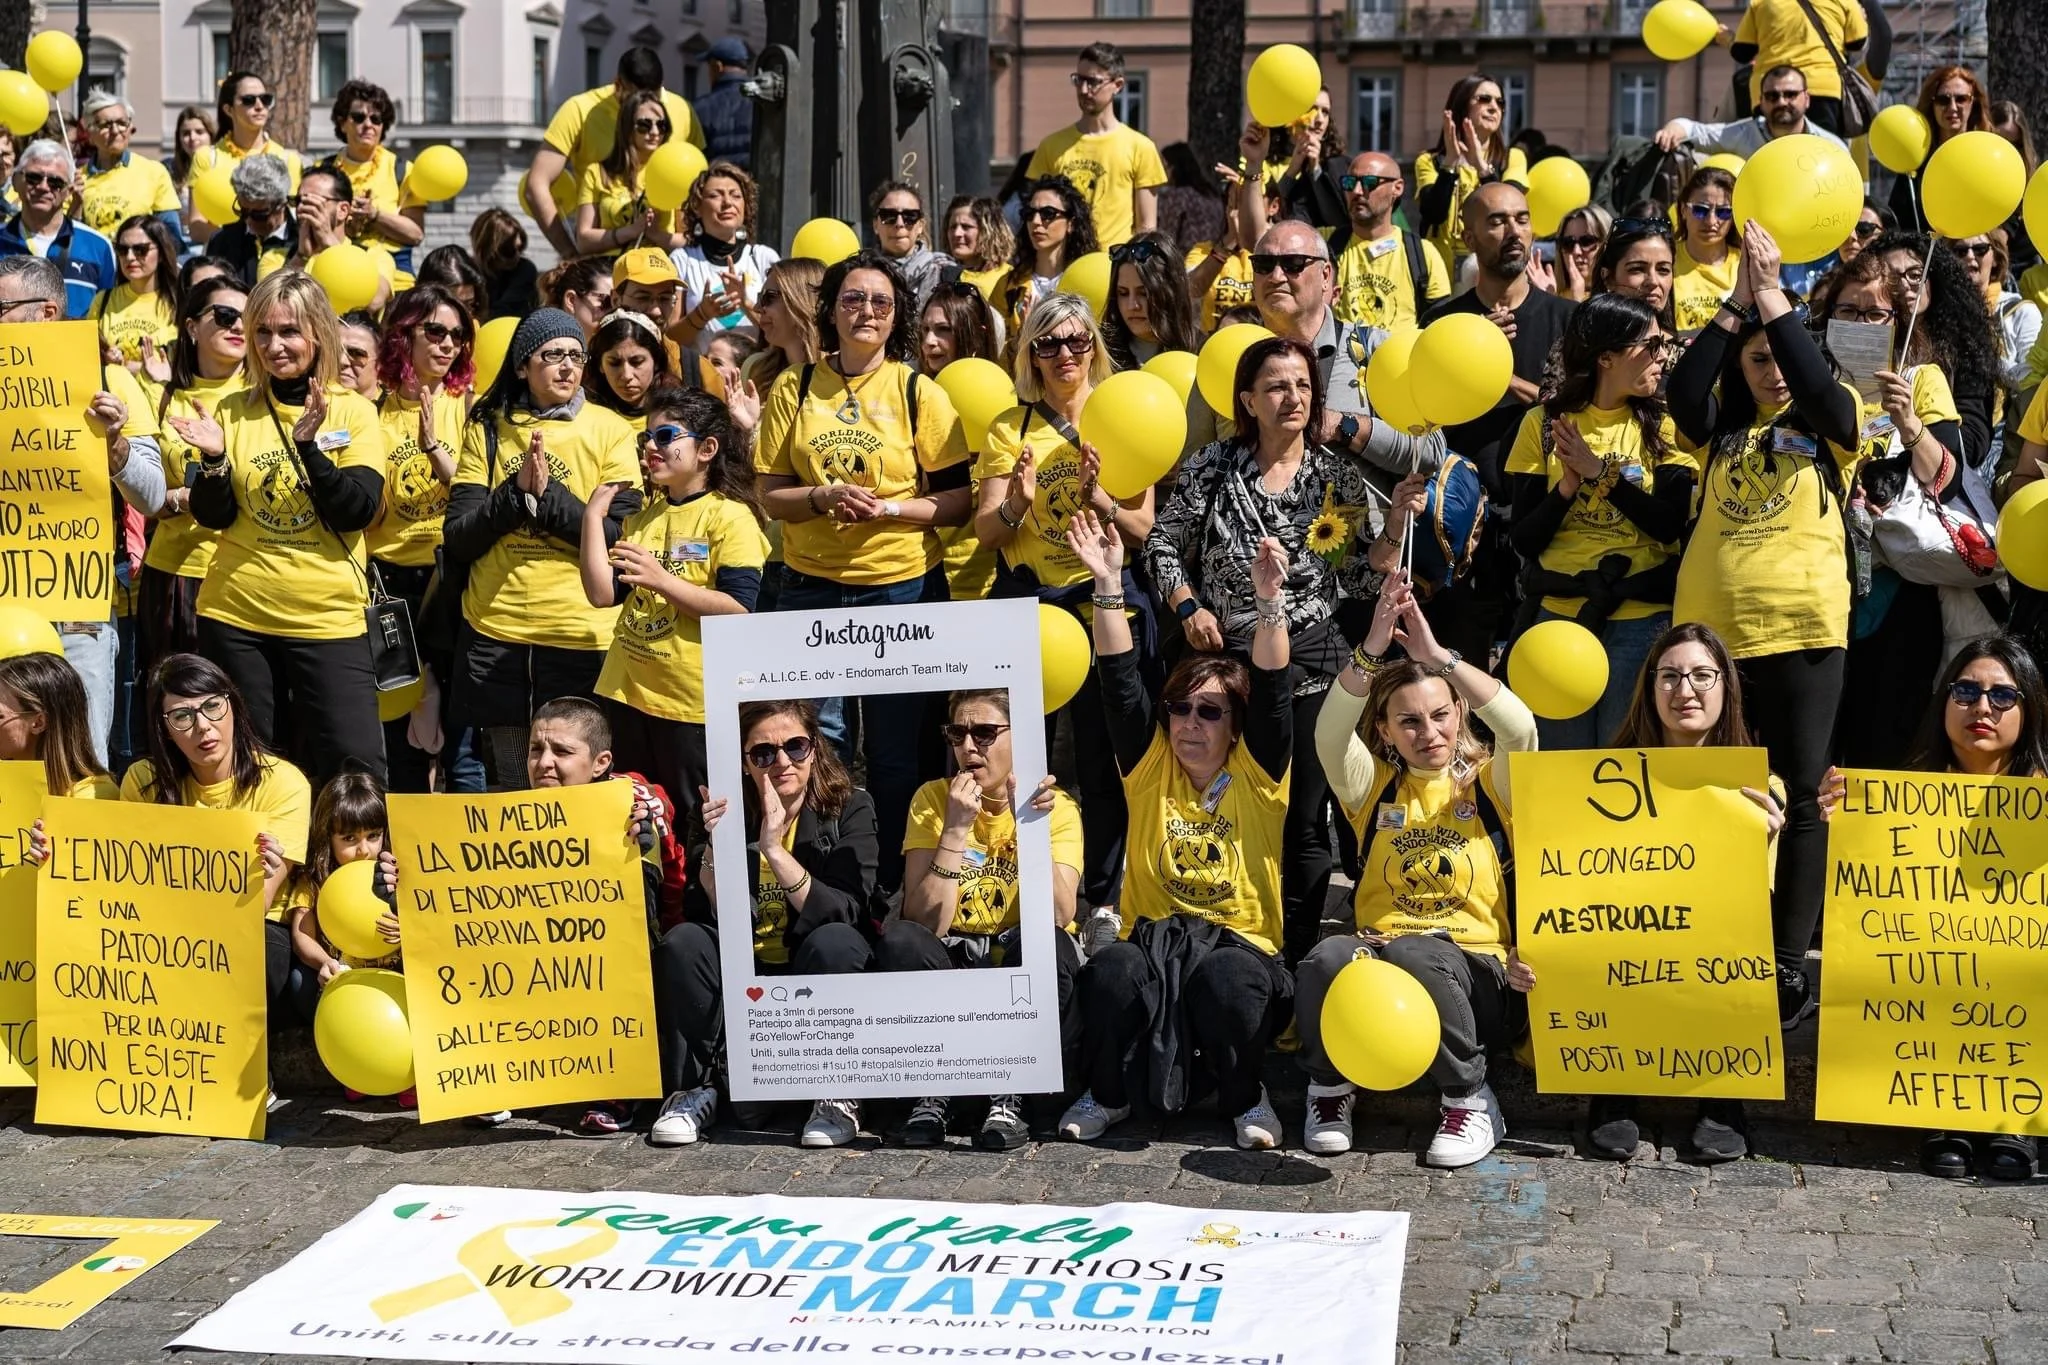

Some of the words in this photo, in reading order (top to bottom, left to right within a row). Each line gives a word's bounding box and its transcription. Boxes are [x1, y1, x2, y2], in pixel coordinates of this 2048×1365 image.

[902, 151, 918, 177] 2
[11, 428, 82, 451] AGILE
[808, 429, 884, 449] WORLDWIDE
[814, 437, 876, 455] ENDOMARCH
[28, 502, 45, 515] AL
[257, 508, 281, 527] 2014
[1722, 497, 1749, 516] 2014
[28, 517, 99, 541] LAVORO
[64, 551, 110, 600] NOI
[804, 618, 935, 659] Instagram
[759, 669, 812, 684] A.L.I.C.E.
[814, 670, 835, 681] odv
[845, 665, 909, 679] Endomarch
[912, 662, 942, 676] Team
[945, 661, 969, 675] Italy
[1843, 776, 2048, 821] L'ENDOMETRIO
[464, 804, 489, 833] IN
[500, 801, 568, 832] MEDIA
[417, 842, 457, 874] LA
[460, 837, 590, 872] DIAGNOSI
[1937, 826, 2006, 859] UNA
[50, 836, 249, 895] L'ENDOMETRIOSI
[1540, 847, 1571, 878] AL
[1578, 843, 1695, 876] CONGEDO
[413, 888, 438, 913] DI
[448, 879, 625, 914] ENDOMETRIOSI
[1169, 879, 1196, 897] 2014
[1834, 860, 1970, 904] MALATTIA
[1981, 866, 2048, 906] SOCI
[99, 899, 140, 922] UNA
[1397, 893, 1424, 913] 2014
[1532, 903, 1692, 935] MESTRUALE
[454, 920, 541, 948] ARRIVA
[545, 917, 606, 943] DOPO
[1861, 908, 1921, 943] CHE
[101, 928, 231, 974] PATOLOGIA
[54, 962, 158, 1006] CRONICA
[527, 953, 604, 996] ANNI
[1607, 958, 1684, 988] NELLE
[1695, 954, 1775, 985] SCUOLE
[1876, 951, 1991, 991] TUTTI,
[102, 1011, 142, 1037] PER
[148, 1016, 166, 1038] LA
[171, 1017, 226, 1045] QUALE
[747, 1008, 773, 1018] Piace
[807, 1007, 816, 1016] di
[818, 1007, 855, 1018] persone
[748, 1019, 793, 1030] Partecipo
[794, 1018, 811, 1028] alla
[813, 1017, 863, 1029] campagna
[865, 1015, 874, 1026] di
[875, 1012, 956, 1026] sensibilizzazione
[957, 1009, 1038, 1023] sull'endometriosi
[1548, 1011, 1568, 1030] E
[1576, 1010, 1608, 1031] SUI
[1863, 999, 1925, 1022] NON
[1951, 1002, 2027, 1029] SOLO
[437, 1016, 599, 1053] DALL'ESORDIO
[612, 1016, 644, 1039] DEI
[749, 1030, 855, 1042] #GoYellowForChange
[51, 1036, 107, 1072] NON
[128, 1043, 217, 1084] ESISTE
[750, 1048, 775, 1059] Uniti,
[778, 1047, 800, 1057] sulla
[802, 1046, 834, 1057] strada
[836, 1045, 859, 1056] della
[861, 1043, 944, 1056] consapevolezza!
[751, 1061, 820, 1073] #endometriosi
[822, 1060, 859, 1071] #1su10
[861, 1058, 934, 1070] #stopalsilenzio
[936, 1054, 1037, 1068] #endometriosiesiste
[1559, 1045, 1625, 1074] POSTI
[1635, 1048, 1655, 1066] DI
[1658, 1035, 1772, 1079] LAVORO!
[1895, 1040, 1936, 1061] CHI
[1958, 1042, 1996, 1065] NE
[437, 1061, 497, 1093] PRIMI
[506, 1047, 615, 1083] SINTOMI!
[903, 1069, 1012, 1082] #endomarchteamitaly
[96, 1078, 194, 1122] CURA!
[556, 1204, 823, 1237] Team
[868, 1215, 1134, 1262] Italy
[645, 1233, 936, 1274] ENDO
[936, 1253, 1225, 1283] METRIOSIS
[484, 1264, 808, 1298] WORLDWIDE
[798, 1274, 1224, 1323] MARCH
[908, 1317, 1012, 1329] FAMILY
[1018, 1321, 1210, 1337] FOUNDATION
[290, 1322, 406, 1344] Uniti,
[428, 1329, 539, 1347] sulla
[557, 1334, 716, 1351] strada
[729, 1335, 851, 1353] della
[871, 1344, 1284, 1365] consapevolezza!
